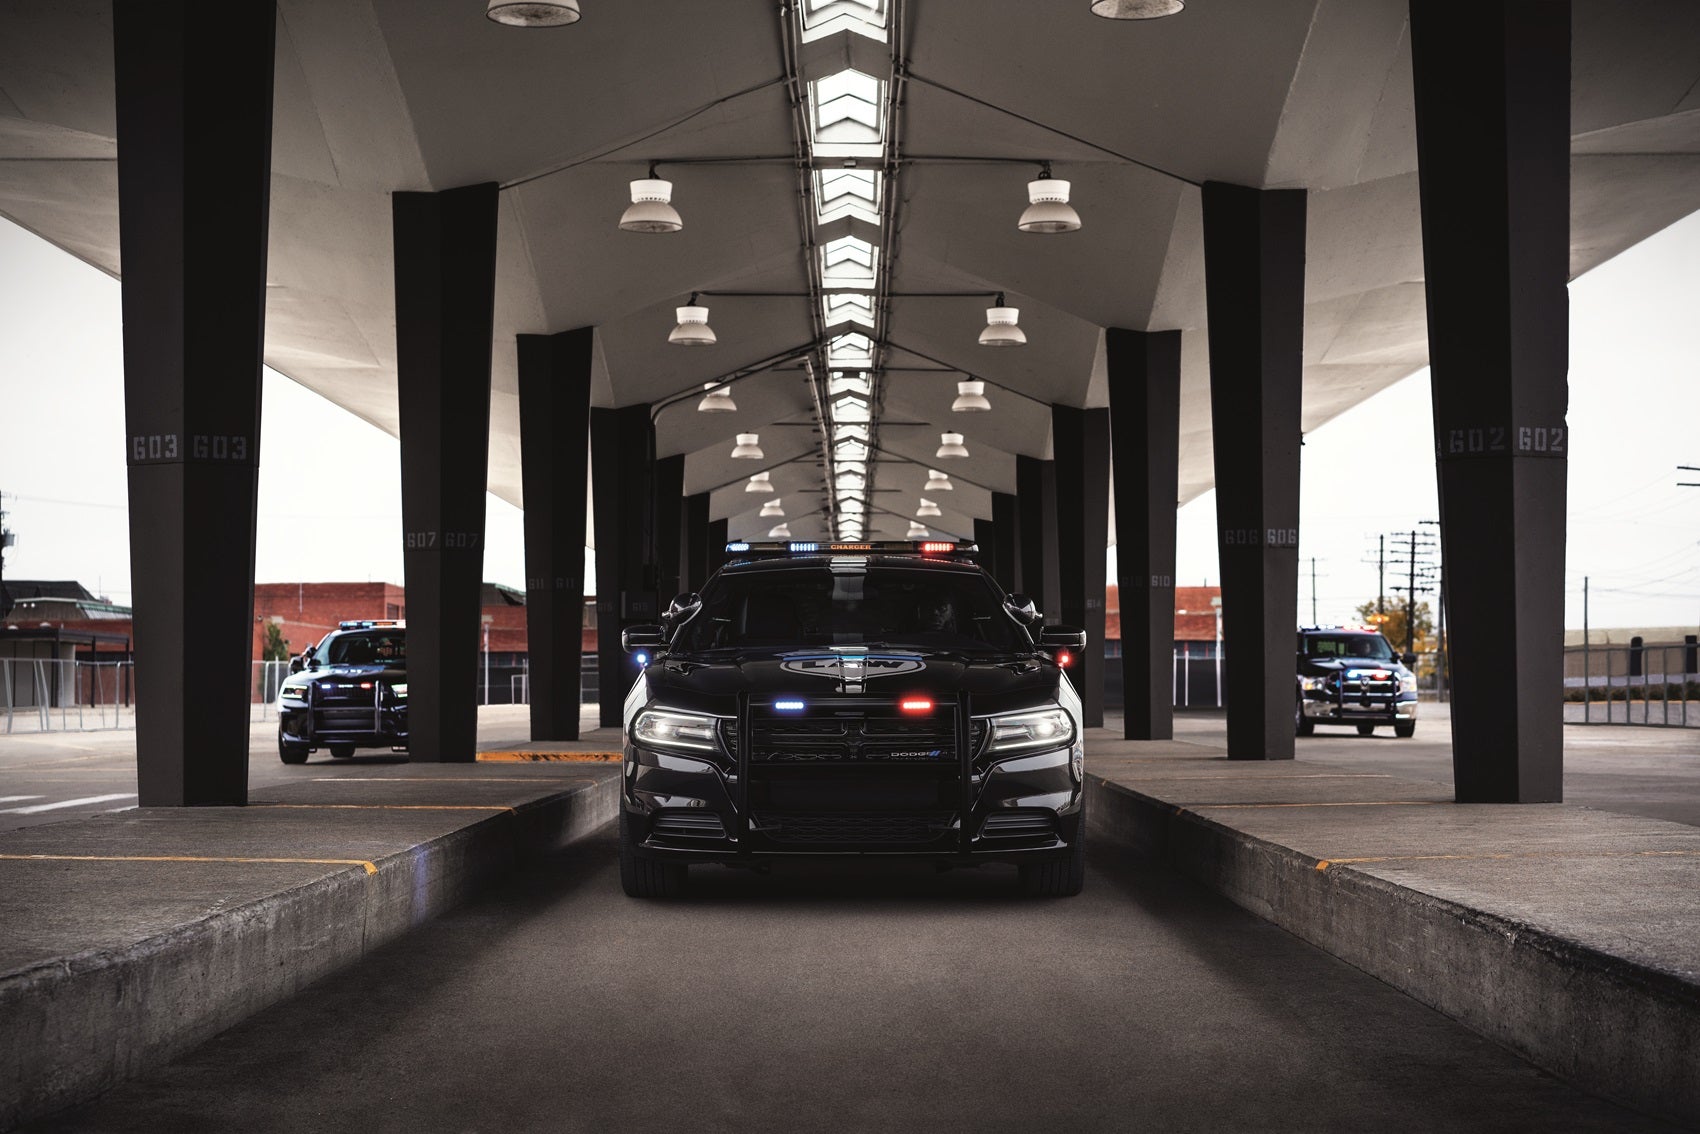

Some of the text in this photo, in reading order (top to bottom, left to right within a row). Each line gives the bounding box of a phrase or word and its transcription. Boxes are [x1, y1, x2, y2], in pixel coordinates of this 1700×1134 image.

[133, 434, 178, 460] 603
[193, 435, 247, 460] 603
[1449, 427, 1505, 453] 602
[1519, 427, 1563, 452] 602
[407, 532, 436, 548] 607
[445, 532, 480, 548] 607
[1267, 528, 1297, 544] 606
[1151, 575, 1170, 587] 610
